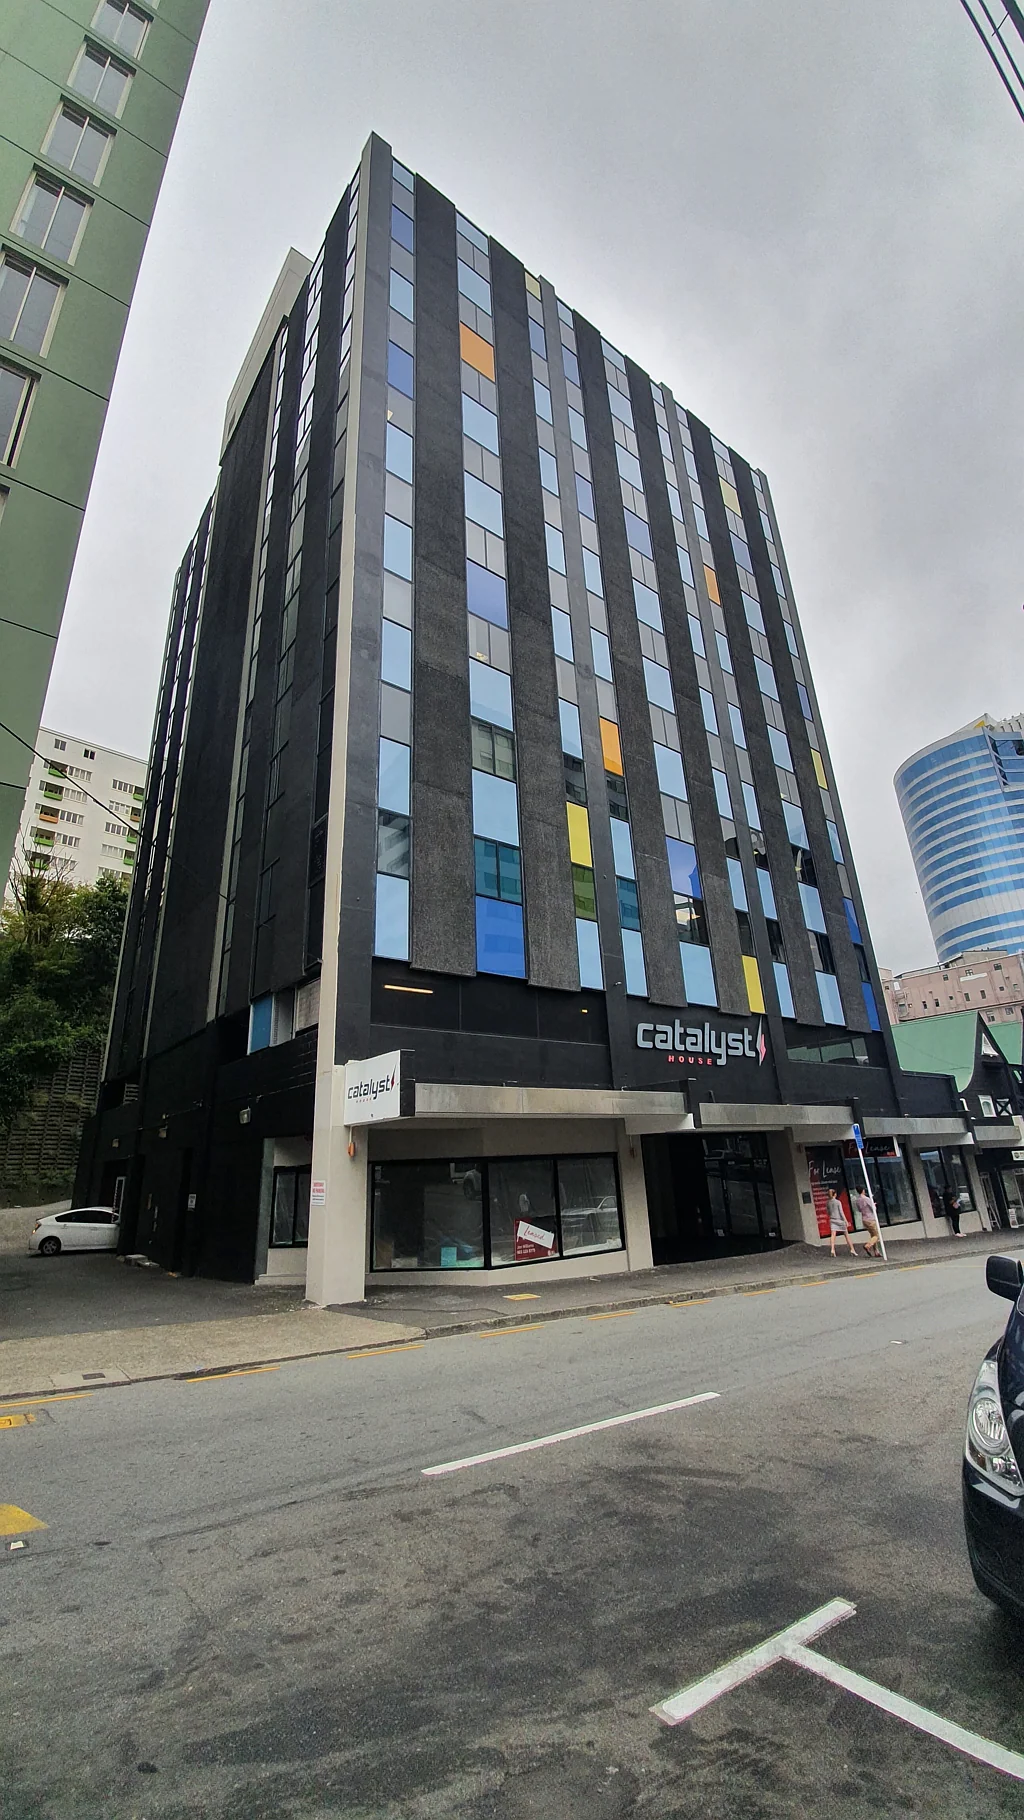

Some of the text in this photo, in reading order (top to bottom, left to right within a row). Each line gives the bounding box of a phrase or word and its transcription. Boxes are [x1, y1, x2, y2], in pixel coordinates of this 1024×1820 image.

[637, 1019, 756, 1066] catalyst
[668, 1055, 713, 1066] HOUSE
[347, 1075, 390, 1100] catalyst
[823, 1160, 841, 1178] Lease
